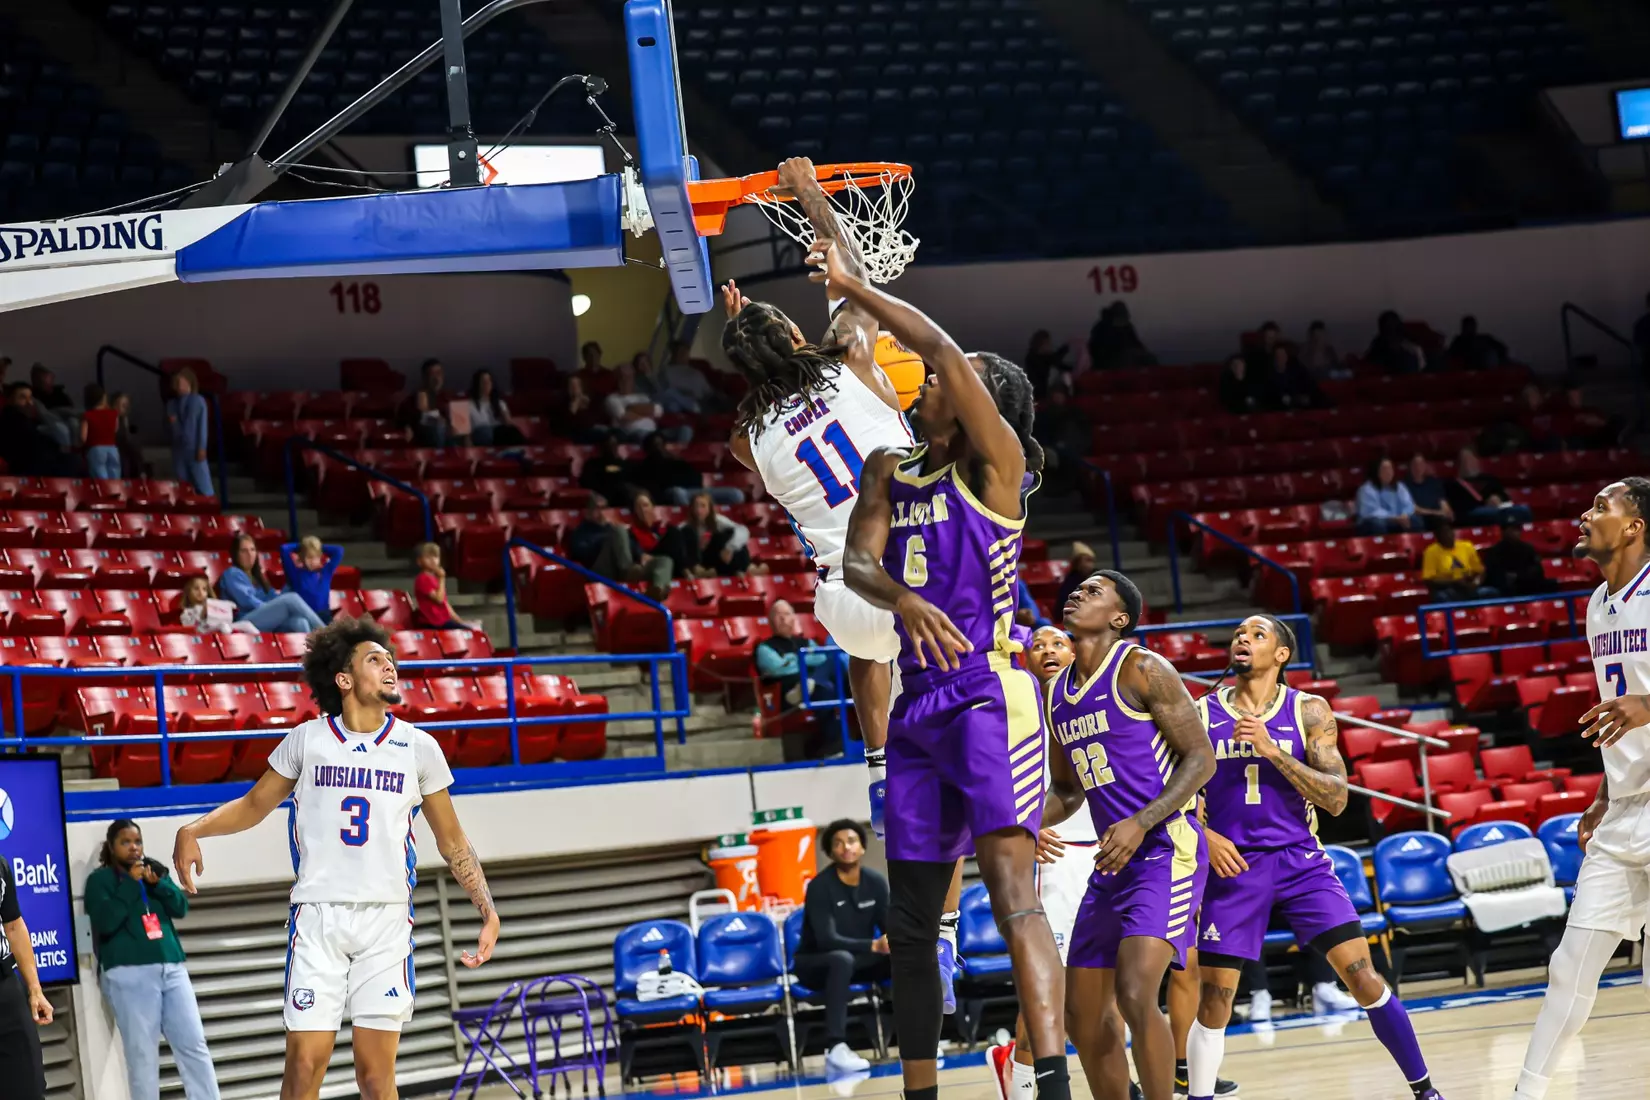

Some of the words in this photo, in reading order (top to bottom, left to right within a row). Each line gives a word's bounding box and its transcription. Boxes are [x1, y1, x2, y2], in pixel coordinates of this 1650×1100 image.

[1087, 264, 1139, 295] 119
[329, 281, 382, 315] 118
[794, 419, 865, 509] 11
[903, 534, 928, 588] 6
[1623, 627, 1648, 654] TECH
[1605, 662, 1628, 698] 7
[1071, 741, 1116, 791] 22
[1216, 738, 1294, 760] ALCN
[314, 765, 373, 790] LOUISIANA
[374, 769, 406, 794] TECH
[1244, 763, 1261, 804] 1
[340, 795, 371, 847] 3
[13, 853, 59, 887] Bank
[30, 929, 59, 948] BANK
[34, 949, 67, 968] LETICS
